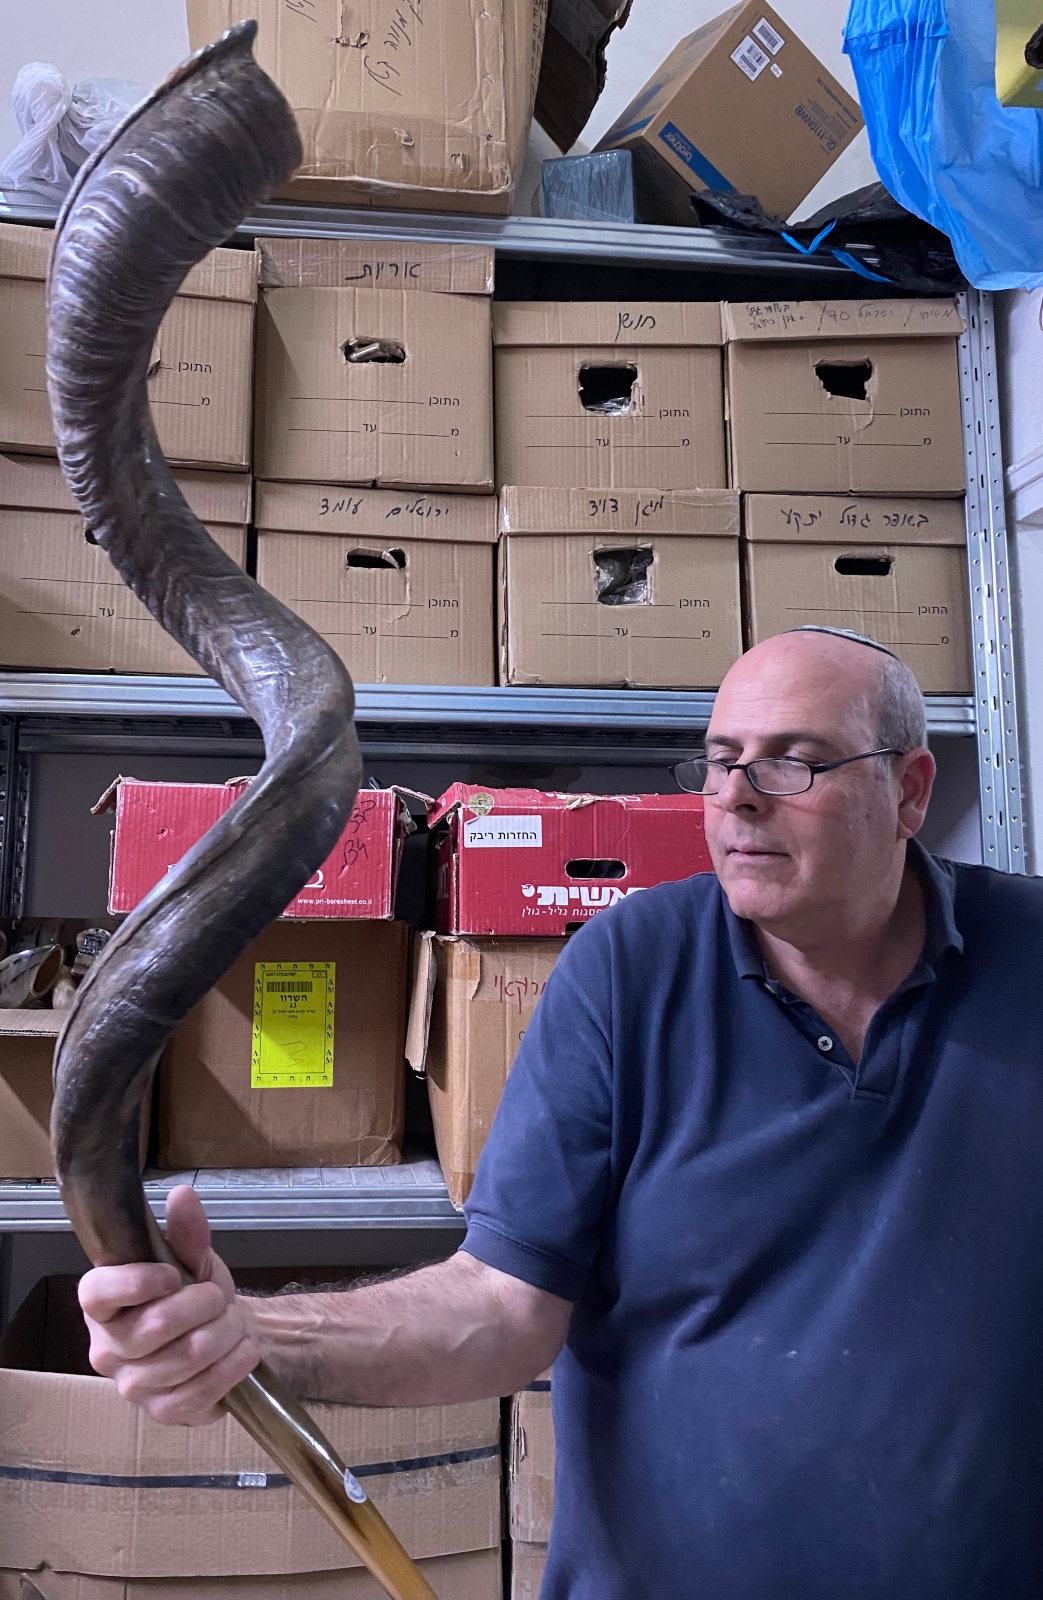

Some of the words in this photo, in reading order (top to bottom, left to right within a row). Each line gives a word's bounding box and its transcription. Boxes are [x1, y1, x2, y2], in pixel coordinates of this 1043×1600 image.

[793, 104, 837, 152] QL-1110NWB
[664, 132, 692, 163] brother
[345, 261, 421, 280] אריות
[858, 304, 894, 319] ישראל
[615, 312, 656, 342] חושן
[178, 361, 212, 374] התוכן
[201, 396, 211, 406] מ
[428, 396, 460, 407] התוכן
[659, 408, 689, 418] התוכן
[900, 407, 930, 417] התוכן
[363, 423, 377, 433] עד
[451, 428, 460, 436] מ
[596, 438, 610, 446] עד
[682, 438, 690, 446] מ
[836, 436, 851, 445] עד
[923, 437, 932, 445] מ
[319, 498, 364, 516] עומד
[386, 498, 449, 518] ירושלים
[634, 496, 664, 526] מגן
[780, 508, 822, 534] יתקע
[840, 505, 870, 528] גדול
[428, 598, 459, 609] התוכן
[679, 598, 710, 608] התוכן
[99, 608, 115, 618] עד
[918, 605, 947, 615] התוכן
[363, 626, 377, 635] עד
[450, 629, 459, 638] מ
[614, 628, 628, 637] עד
[702, 630, 710, 638] מ
[941, 636, 949, 645] מ
[470, 830, 494, 842] ריבק
[498, 831, 537, 840] החזרות
[298, 898, 372, 906] www.pri-beresheet.co.il
